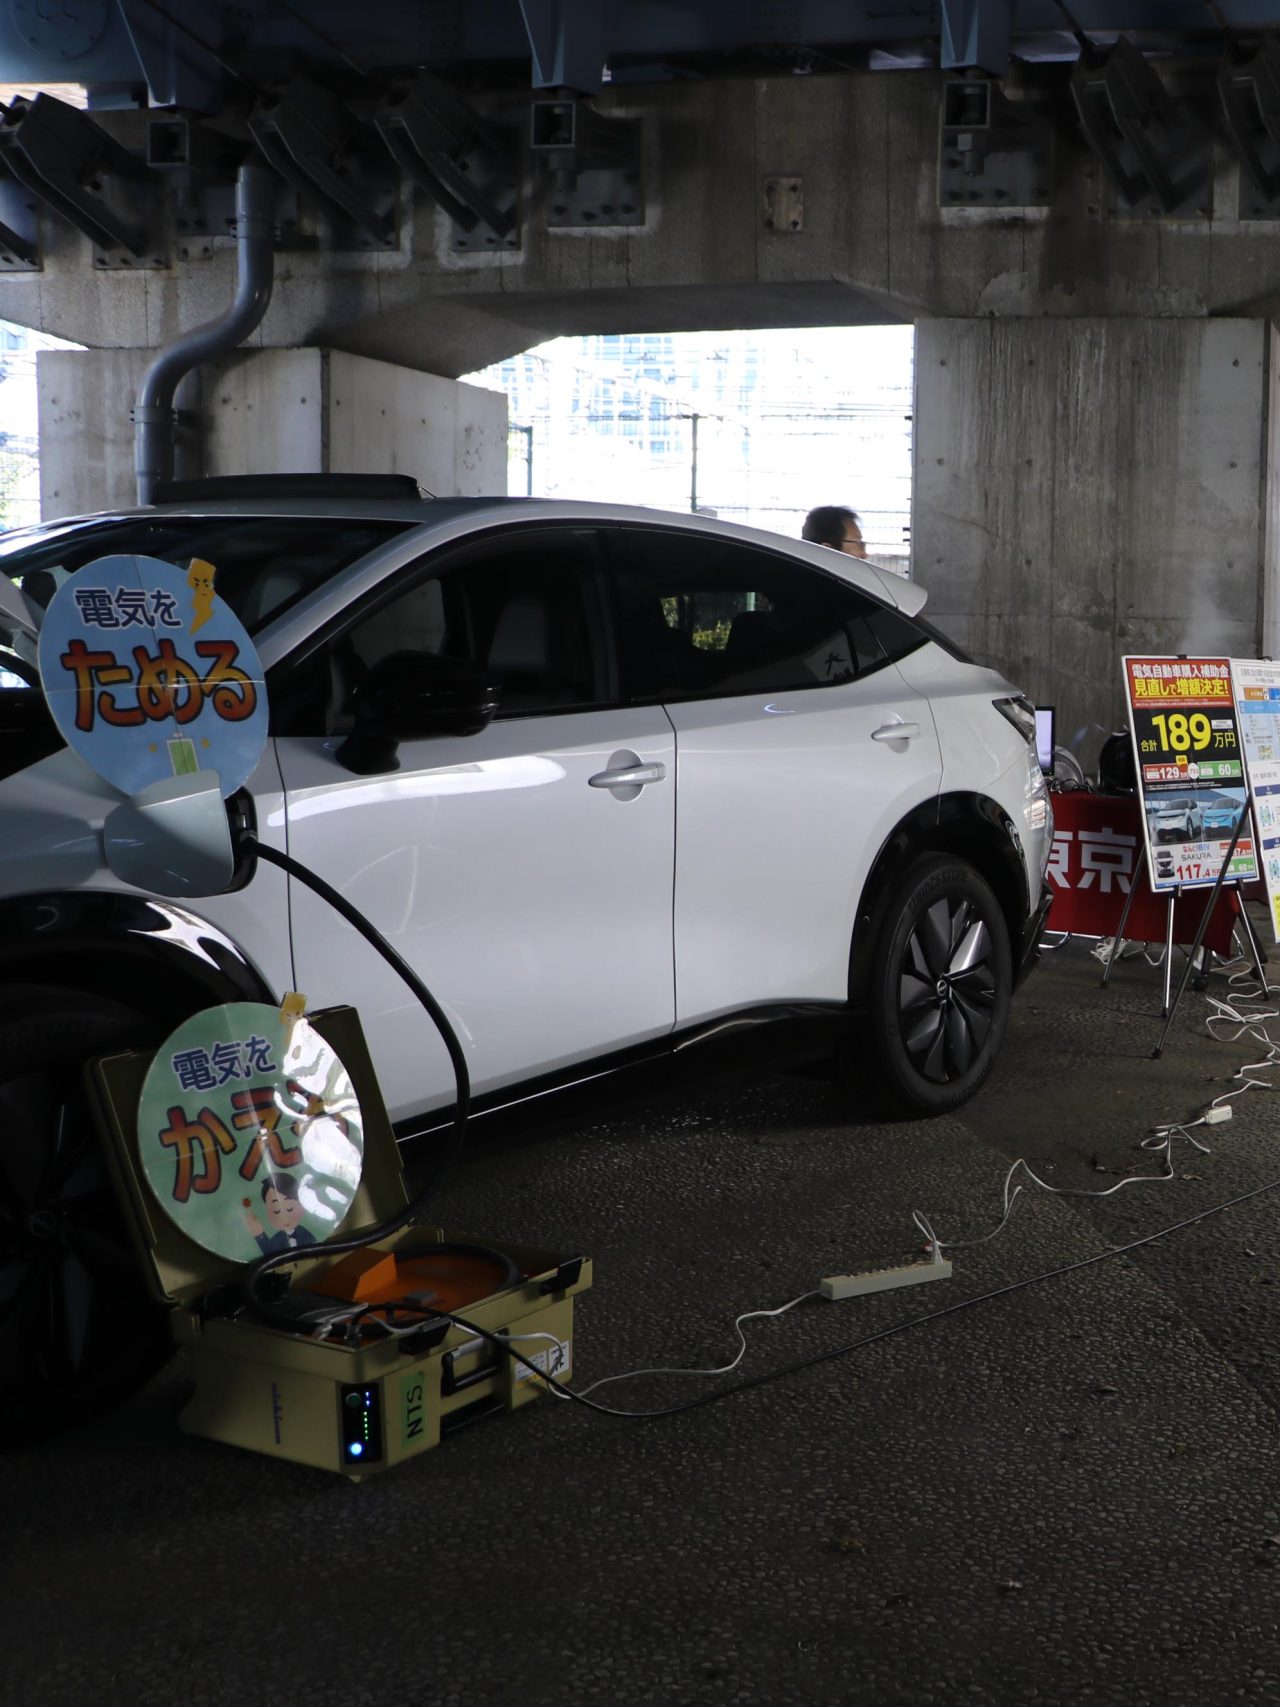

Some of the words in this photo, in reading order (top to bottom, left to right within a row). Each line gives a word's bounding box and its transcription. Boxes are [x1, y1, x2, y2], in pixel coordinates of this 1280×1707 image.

[75, 587, 182, 629] 電気を
[60, 638, 257, 732] ためる
[1132, 664, 1229, 678] 電気自動車購入補助金
[1181, 852, 1212, 861] SAKURA
[172, 1035, 277, 1092] 電気を
[407, 1384, 423, 1439] NTS
